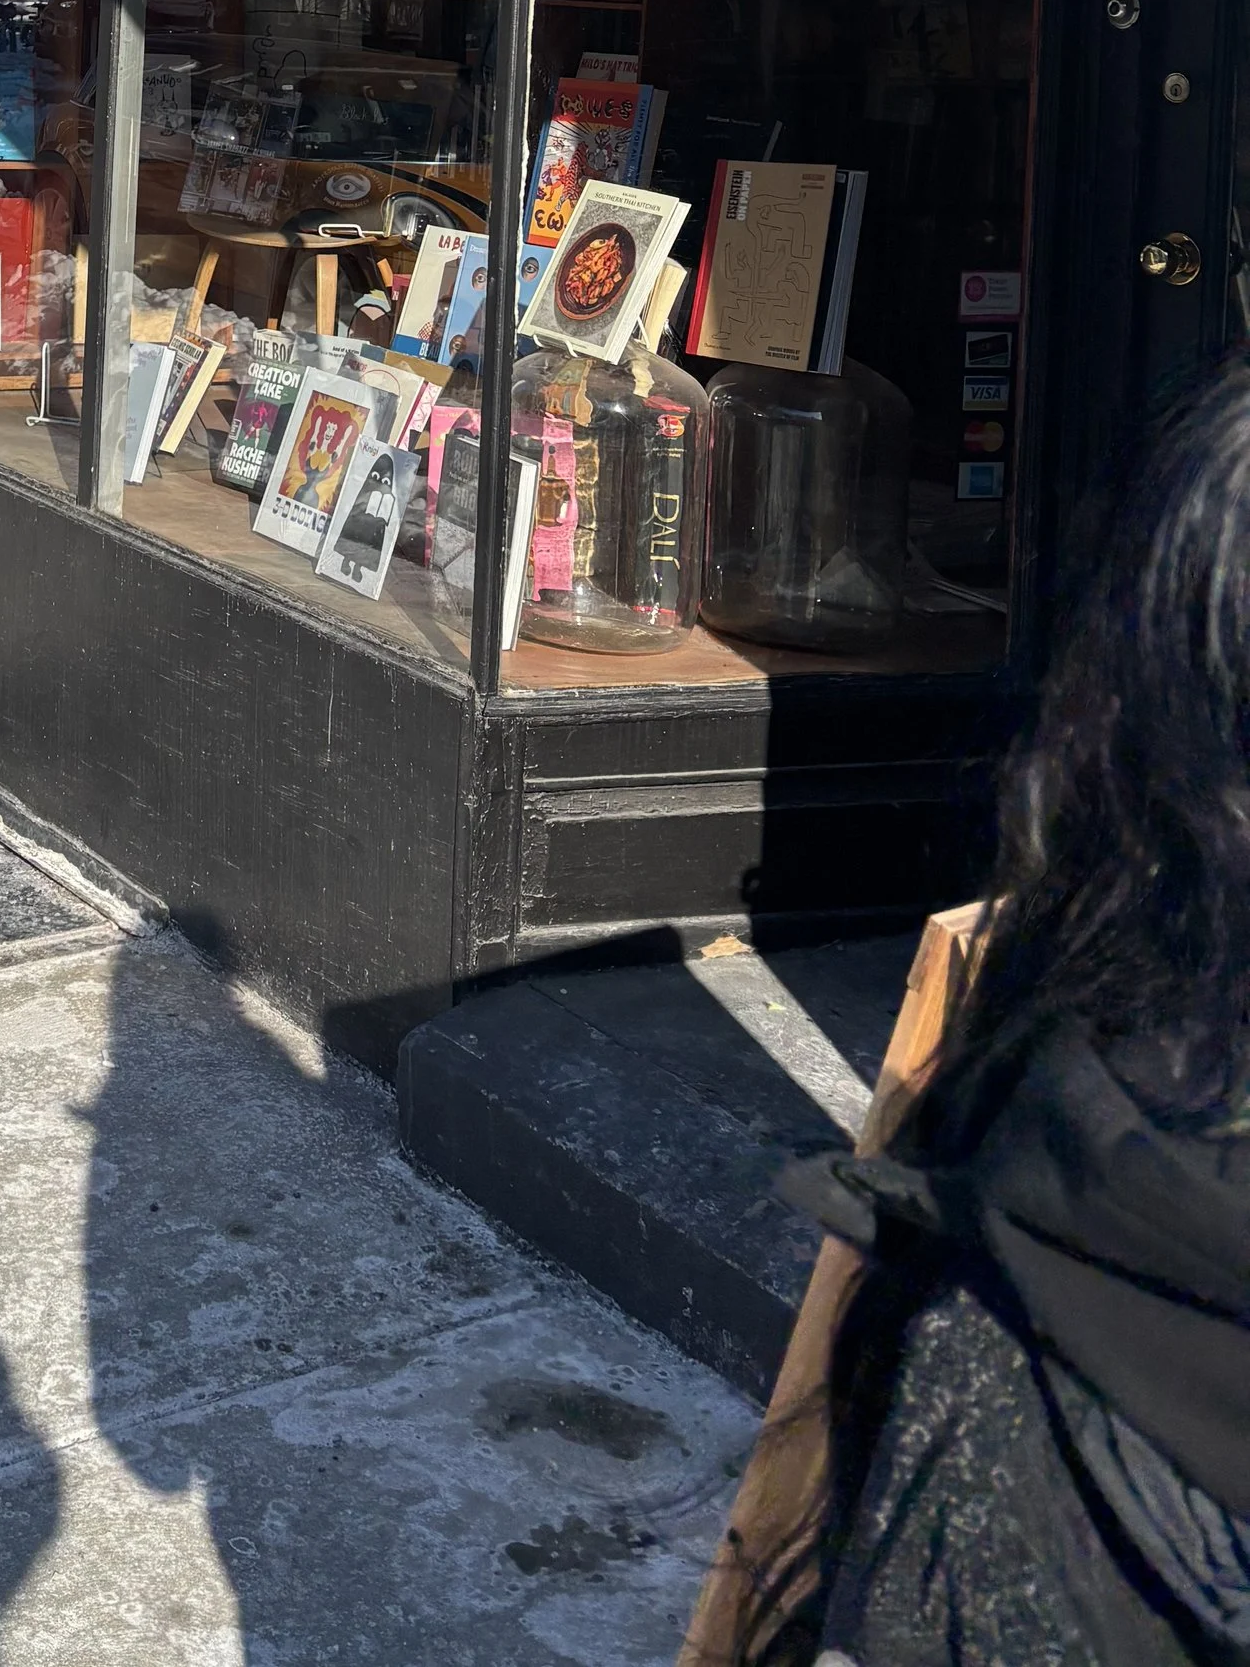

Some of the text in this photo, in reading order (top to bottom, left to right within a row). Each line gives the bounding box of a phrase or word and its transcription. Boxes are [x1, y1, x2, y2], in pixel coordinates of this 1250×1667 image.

[595, 192, 623, 206] SOUTHERN
[623, 198, 637, 207] THAI
[637, 201, 662, 212] KITCHEN
[727, 170, 743, 220] EISENSTEIN
[737, 170, 753, 221] ON PAPER
[438, 235, 451, 249] LA
[248, 363, 300, 388] CREATION
[254, 381, 284, 400] LAKE
[970, 387, 1002, 400] VISA
